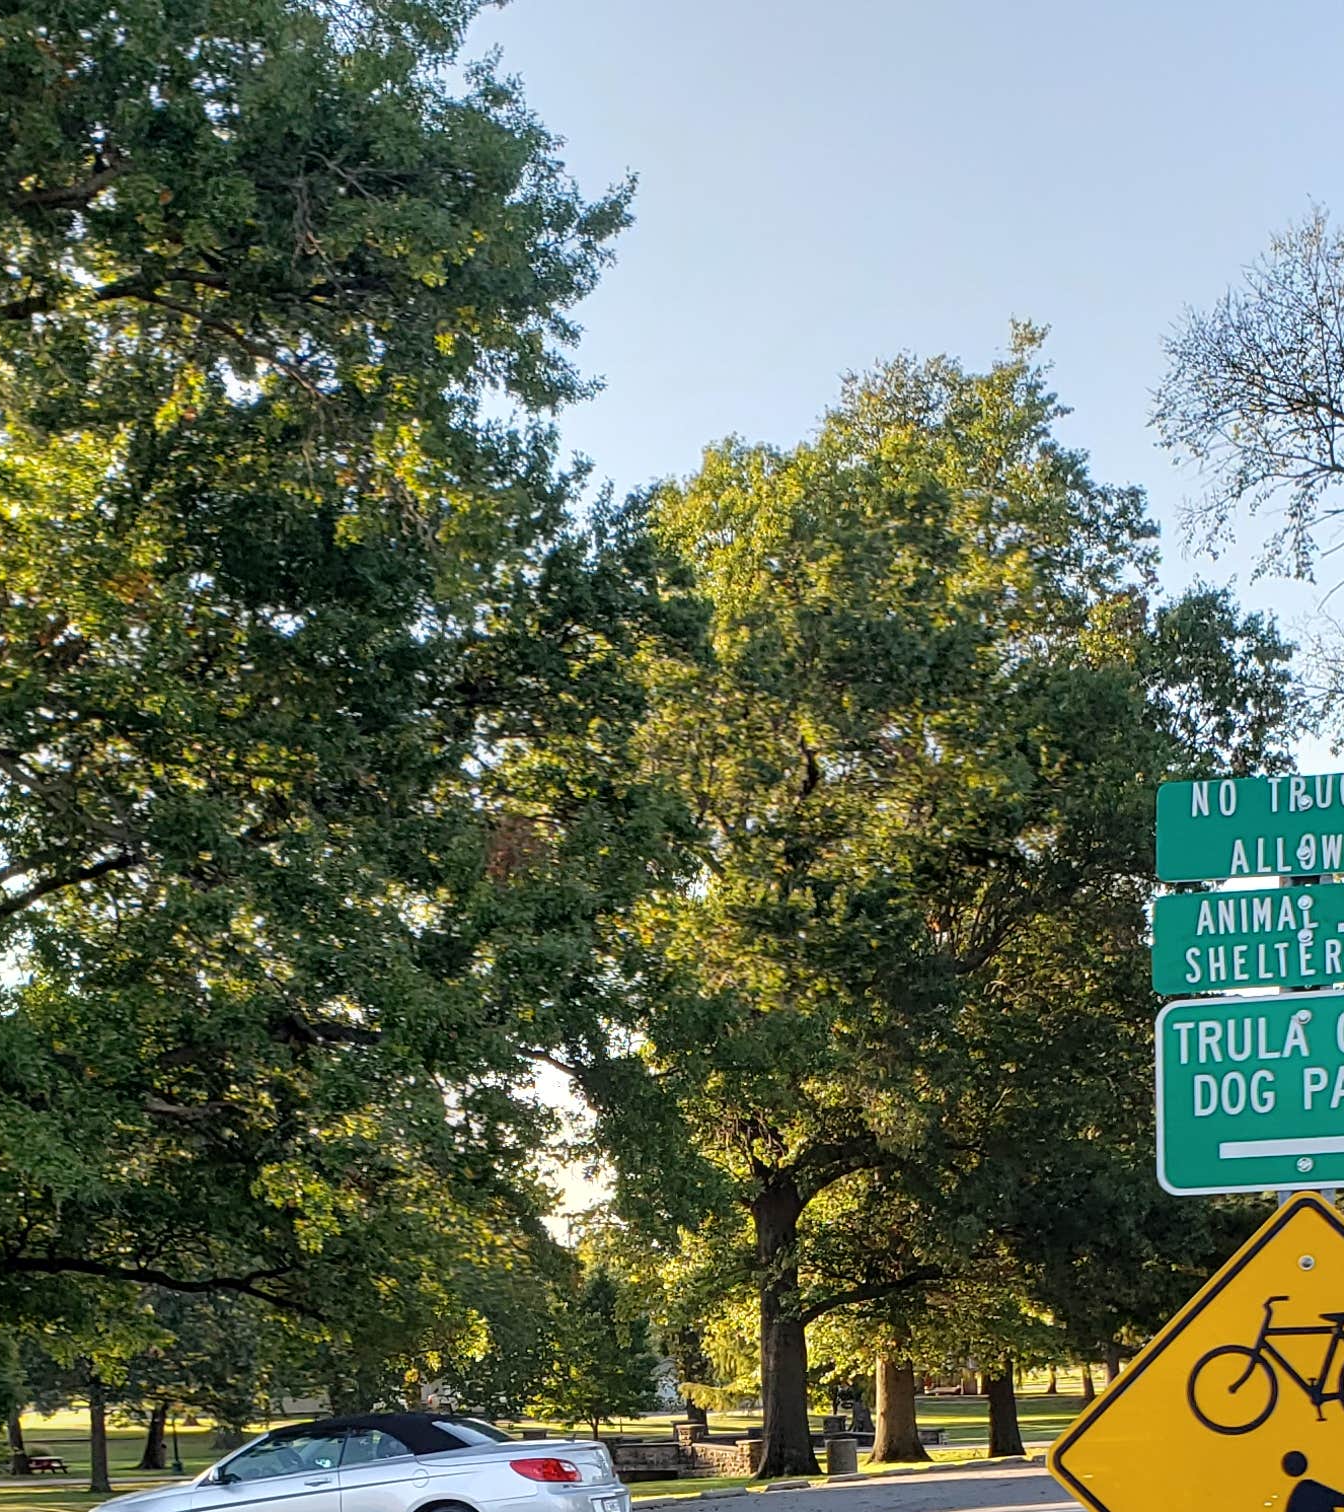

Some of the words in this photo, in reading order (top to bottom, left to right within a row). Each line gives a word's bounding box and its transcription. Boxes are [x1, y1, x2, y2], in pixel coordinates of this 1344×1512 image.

[1191, 780, 1237, 817] NO
[1196, 895, 1318, 936] ANIMAL
[1185, 939, 1342, 984] SHELTER
[1173, 1014, 1310, 1065] TRULA
[1193, 1069, 1276, 1118] DOG
